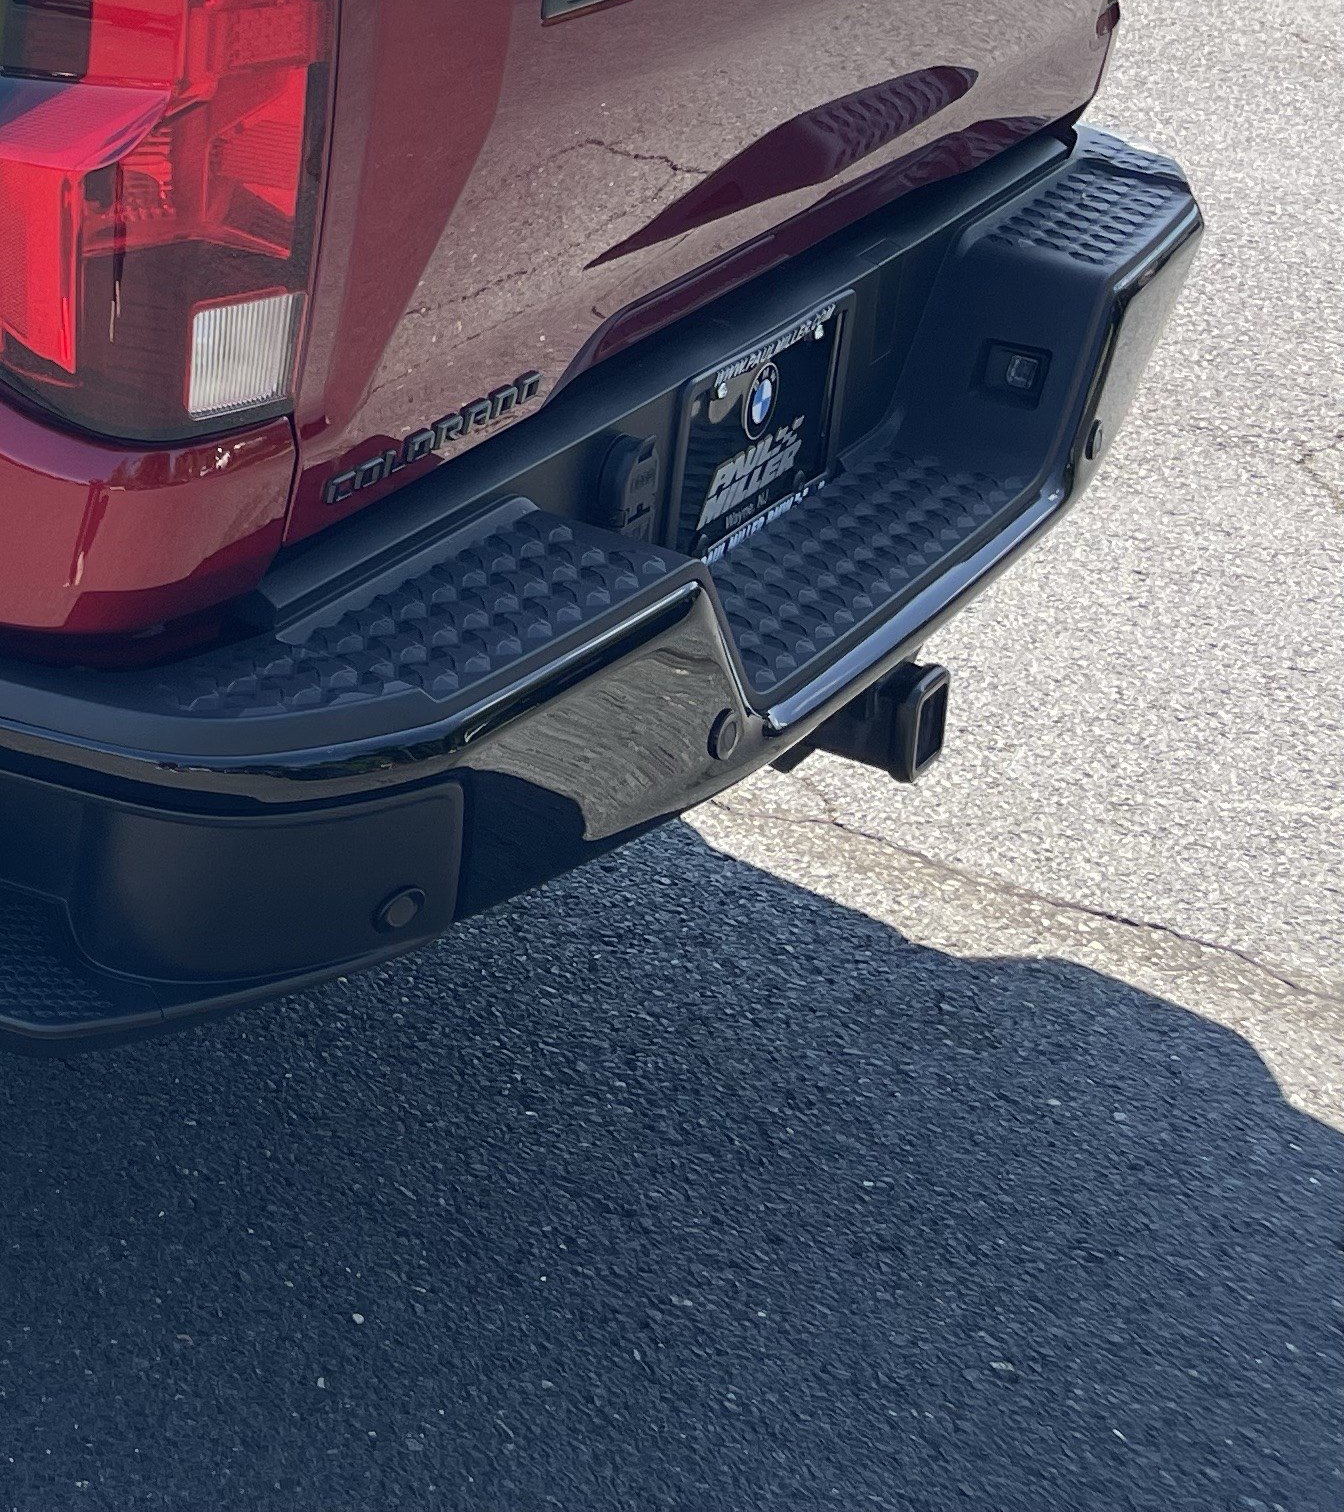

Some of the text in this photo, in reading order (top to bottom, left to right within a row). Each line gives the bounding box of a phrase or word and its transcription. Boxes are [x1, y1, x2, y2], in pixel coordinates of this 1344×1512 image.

[322, 369, 543, 505] COLORADO
[707, 434, 782, 499] PAUL
[696, 439, 803, 531] MILLER
